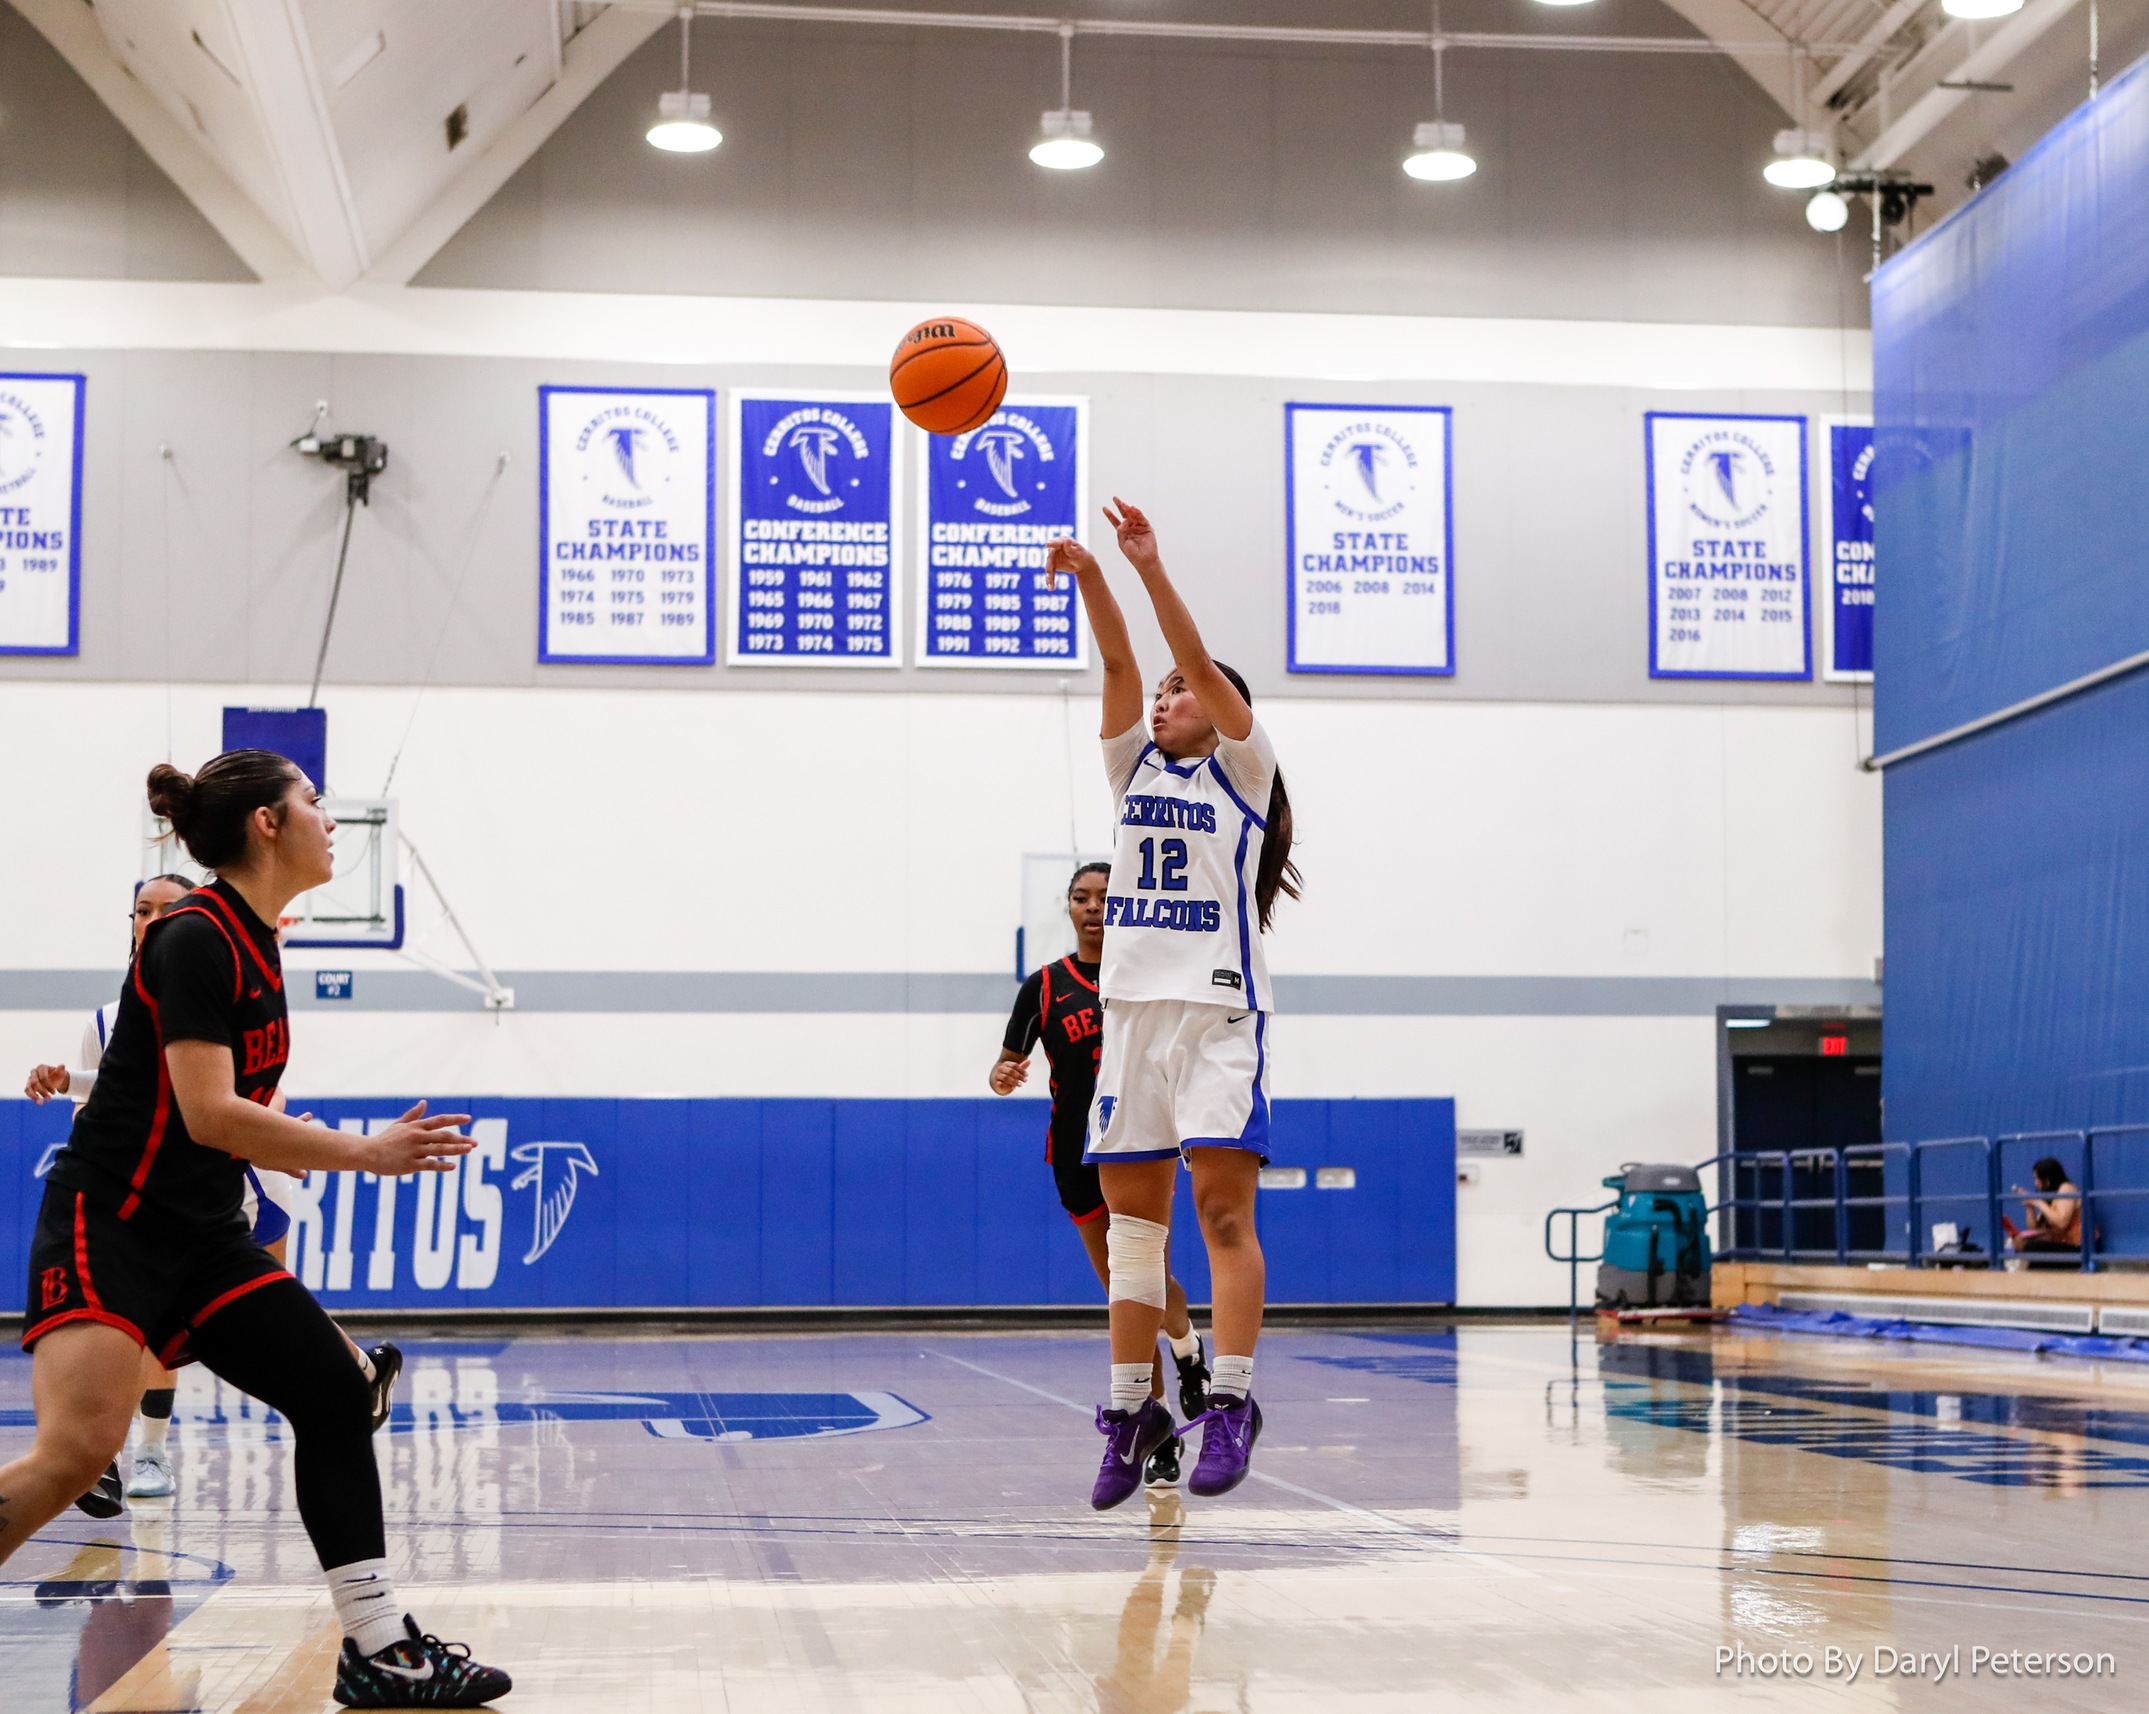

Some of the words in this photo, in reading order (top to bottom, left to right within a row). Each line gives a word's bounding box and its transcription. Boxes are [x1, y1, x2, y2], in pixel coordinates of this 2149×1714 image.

[821, 409, 869, 459] COLLEGE
[1007, 412, 1055, 462] COLLEGE
[1375, 423, 1418, 468] COLLEGE
[588, 519, 667, 538] STATE
[744, 520, 888, 543] CONFERENCE
[932, 522, 1074, 545] CONFERENCE
[1333, 532, 1409, 551] STATE
[1692, 540, 1767, 558] STATE
[556, 542, 699, 562] CHAMPIONS
[743, 543, 888, 566] CHAMPIONS
[932, 545, 1047, 568] CHAMPIO
[1303, 554, 1439, 574] CHAMPIONS
[1664, 561, 1797, 582] CHAMPIONS
[560, 569, 595, 582] 1966
[611, 569, 645, 583] 1970
[799, 570, 832, 587] 1961
[847, 571, 883, 588] 1962
[936, 571, 973, 589] 1976
[985, 572, 1021, 590] 1977
[560, 590, 594, 603] 1974
[611, 591, 645, 604] 1975
[661, 591, 694, 604] 1979
[1306, 580, 1342, 594] 2006
[1353, 581, 1389, 594] 2008
[1402, 582, 1435, 595] 2014
[1667, 587, 1701, 600] 2007
[1712, 588, 1748, 601] 2008
[1760, 589, 1792, 602] 2012
[797, 592, 834, 609] 1966
[847, 593, 883, 610] 1967
[936, 592, 973, 610] 1979
[1308, 602, 1341, 615] 2018
[560, 612, 594, 625] 1985
[610, 612, 644, 625] 1987
[797, 613, 834, 630] 1970
[847, 614, 883, 631] 1972
[1669, 608, 1701, 621] 2013
[1713, 609, 1746, 622] 2014
[1760, 609, 1793, 622] 2015
[748, 633, 784, 651] 1973
[797, 634, 834, 651] 1974
[847, 635, 884, 652] 1975
[937, 635, 970, 652] 1991
[984, 636, 1020, 654] 1992
[1669, 629, 1701, 642] 2016
[1137, 837, 1188, 891] 12
[1104, 896, 1221, 932] FALCONS
[318, 973, 350, 985] COURT
[328, 985, 341, 996] #2
[243, 1017, 288, 1076] BEA
[1823, 1036, 1848, 1056] EXIT
[284, 1118, 508, 1291] RITOS
